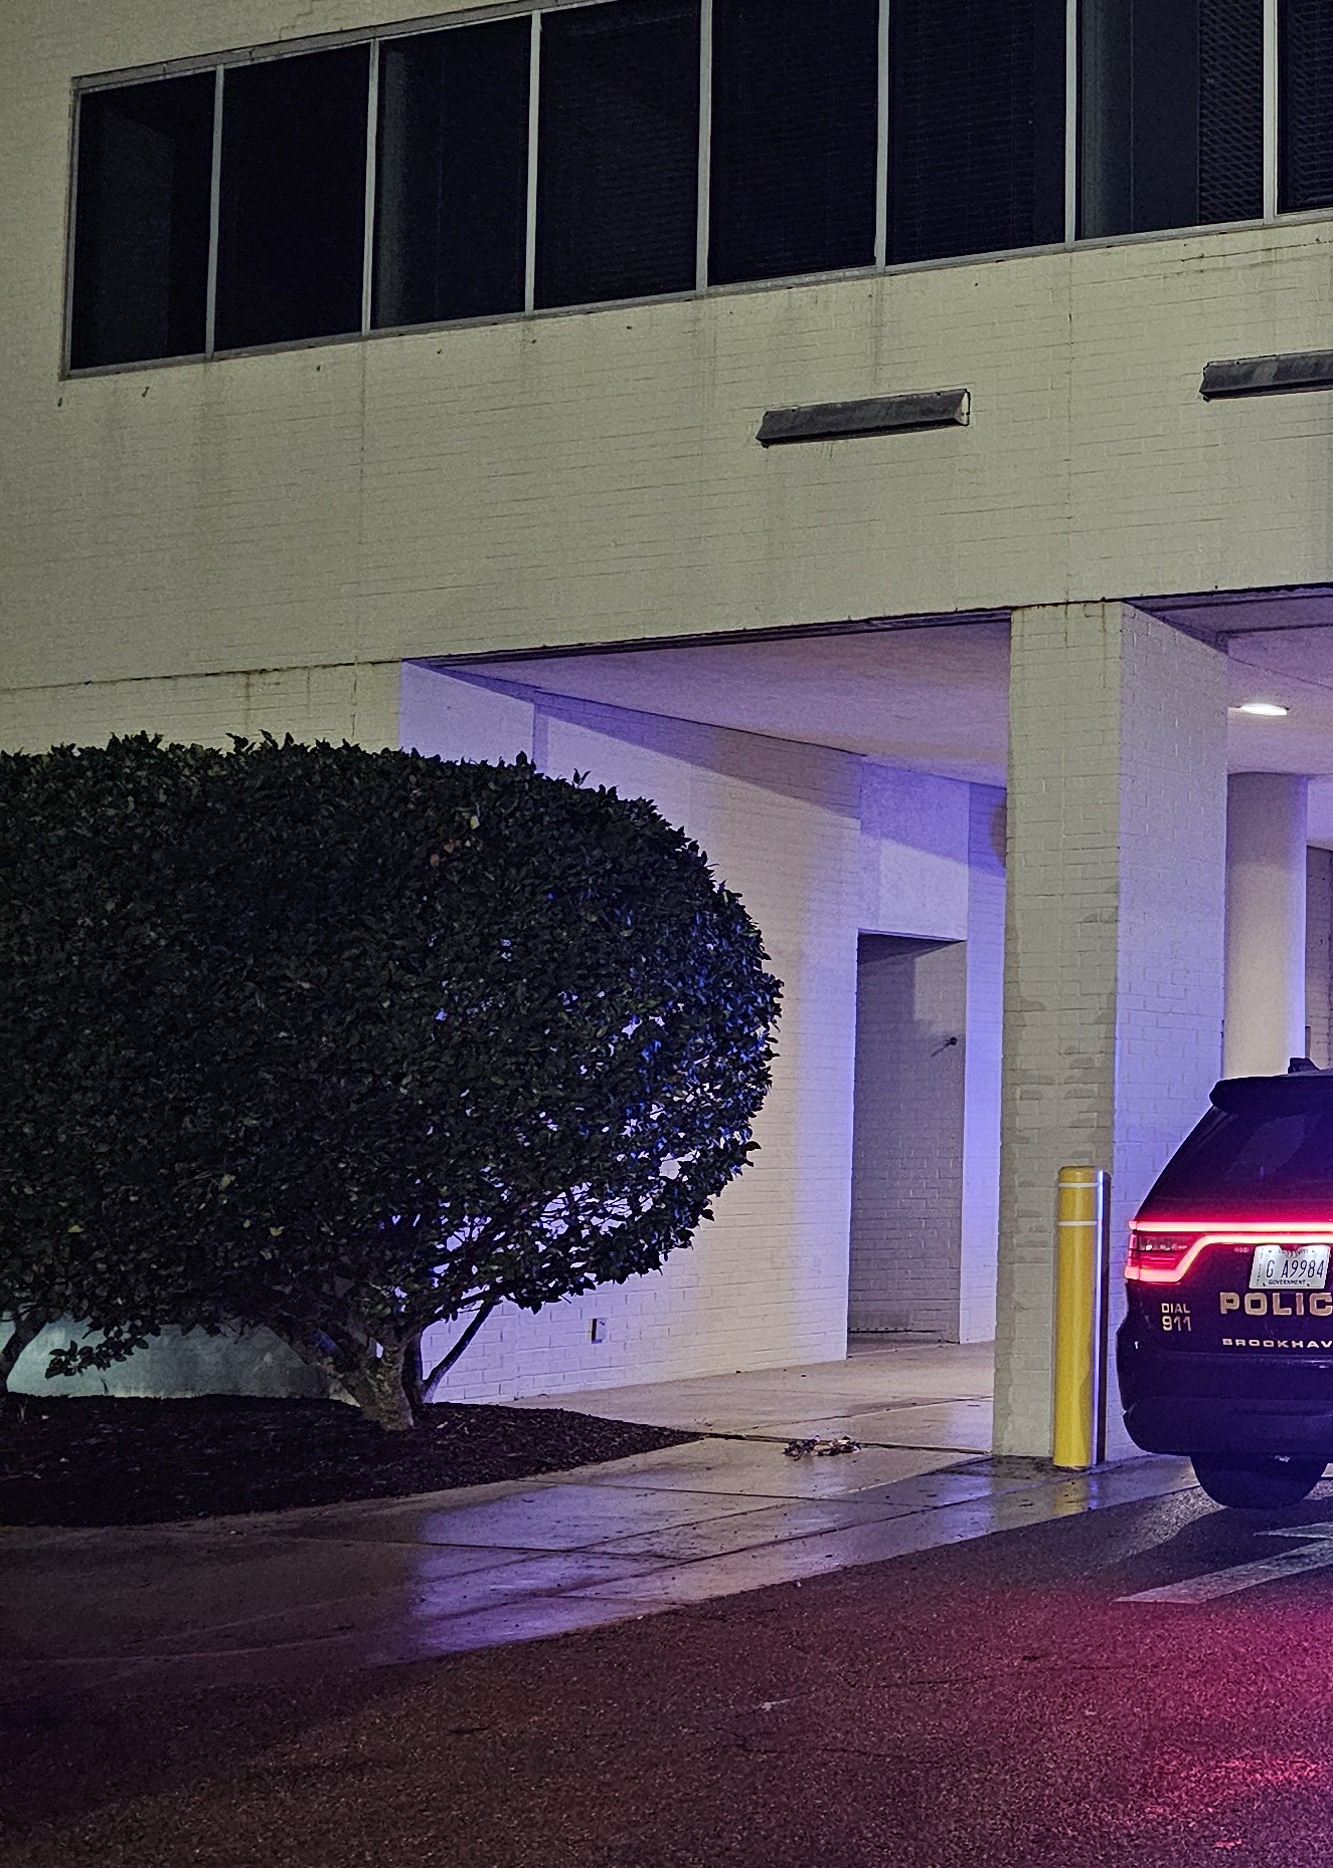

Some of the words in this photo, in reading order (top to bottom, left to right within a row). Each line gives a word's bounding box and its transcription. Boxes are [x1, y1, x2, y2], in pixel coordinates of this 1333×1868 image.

[1266, 1260, 1275, 1278] G
[1281, 1260, 1325, 1279] A9984
[1161, 1302, 1191, 1314] DIAL
[1162, 1315, 1193, 1332] 911
